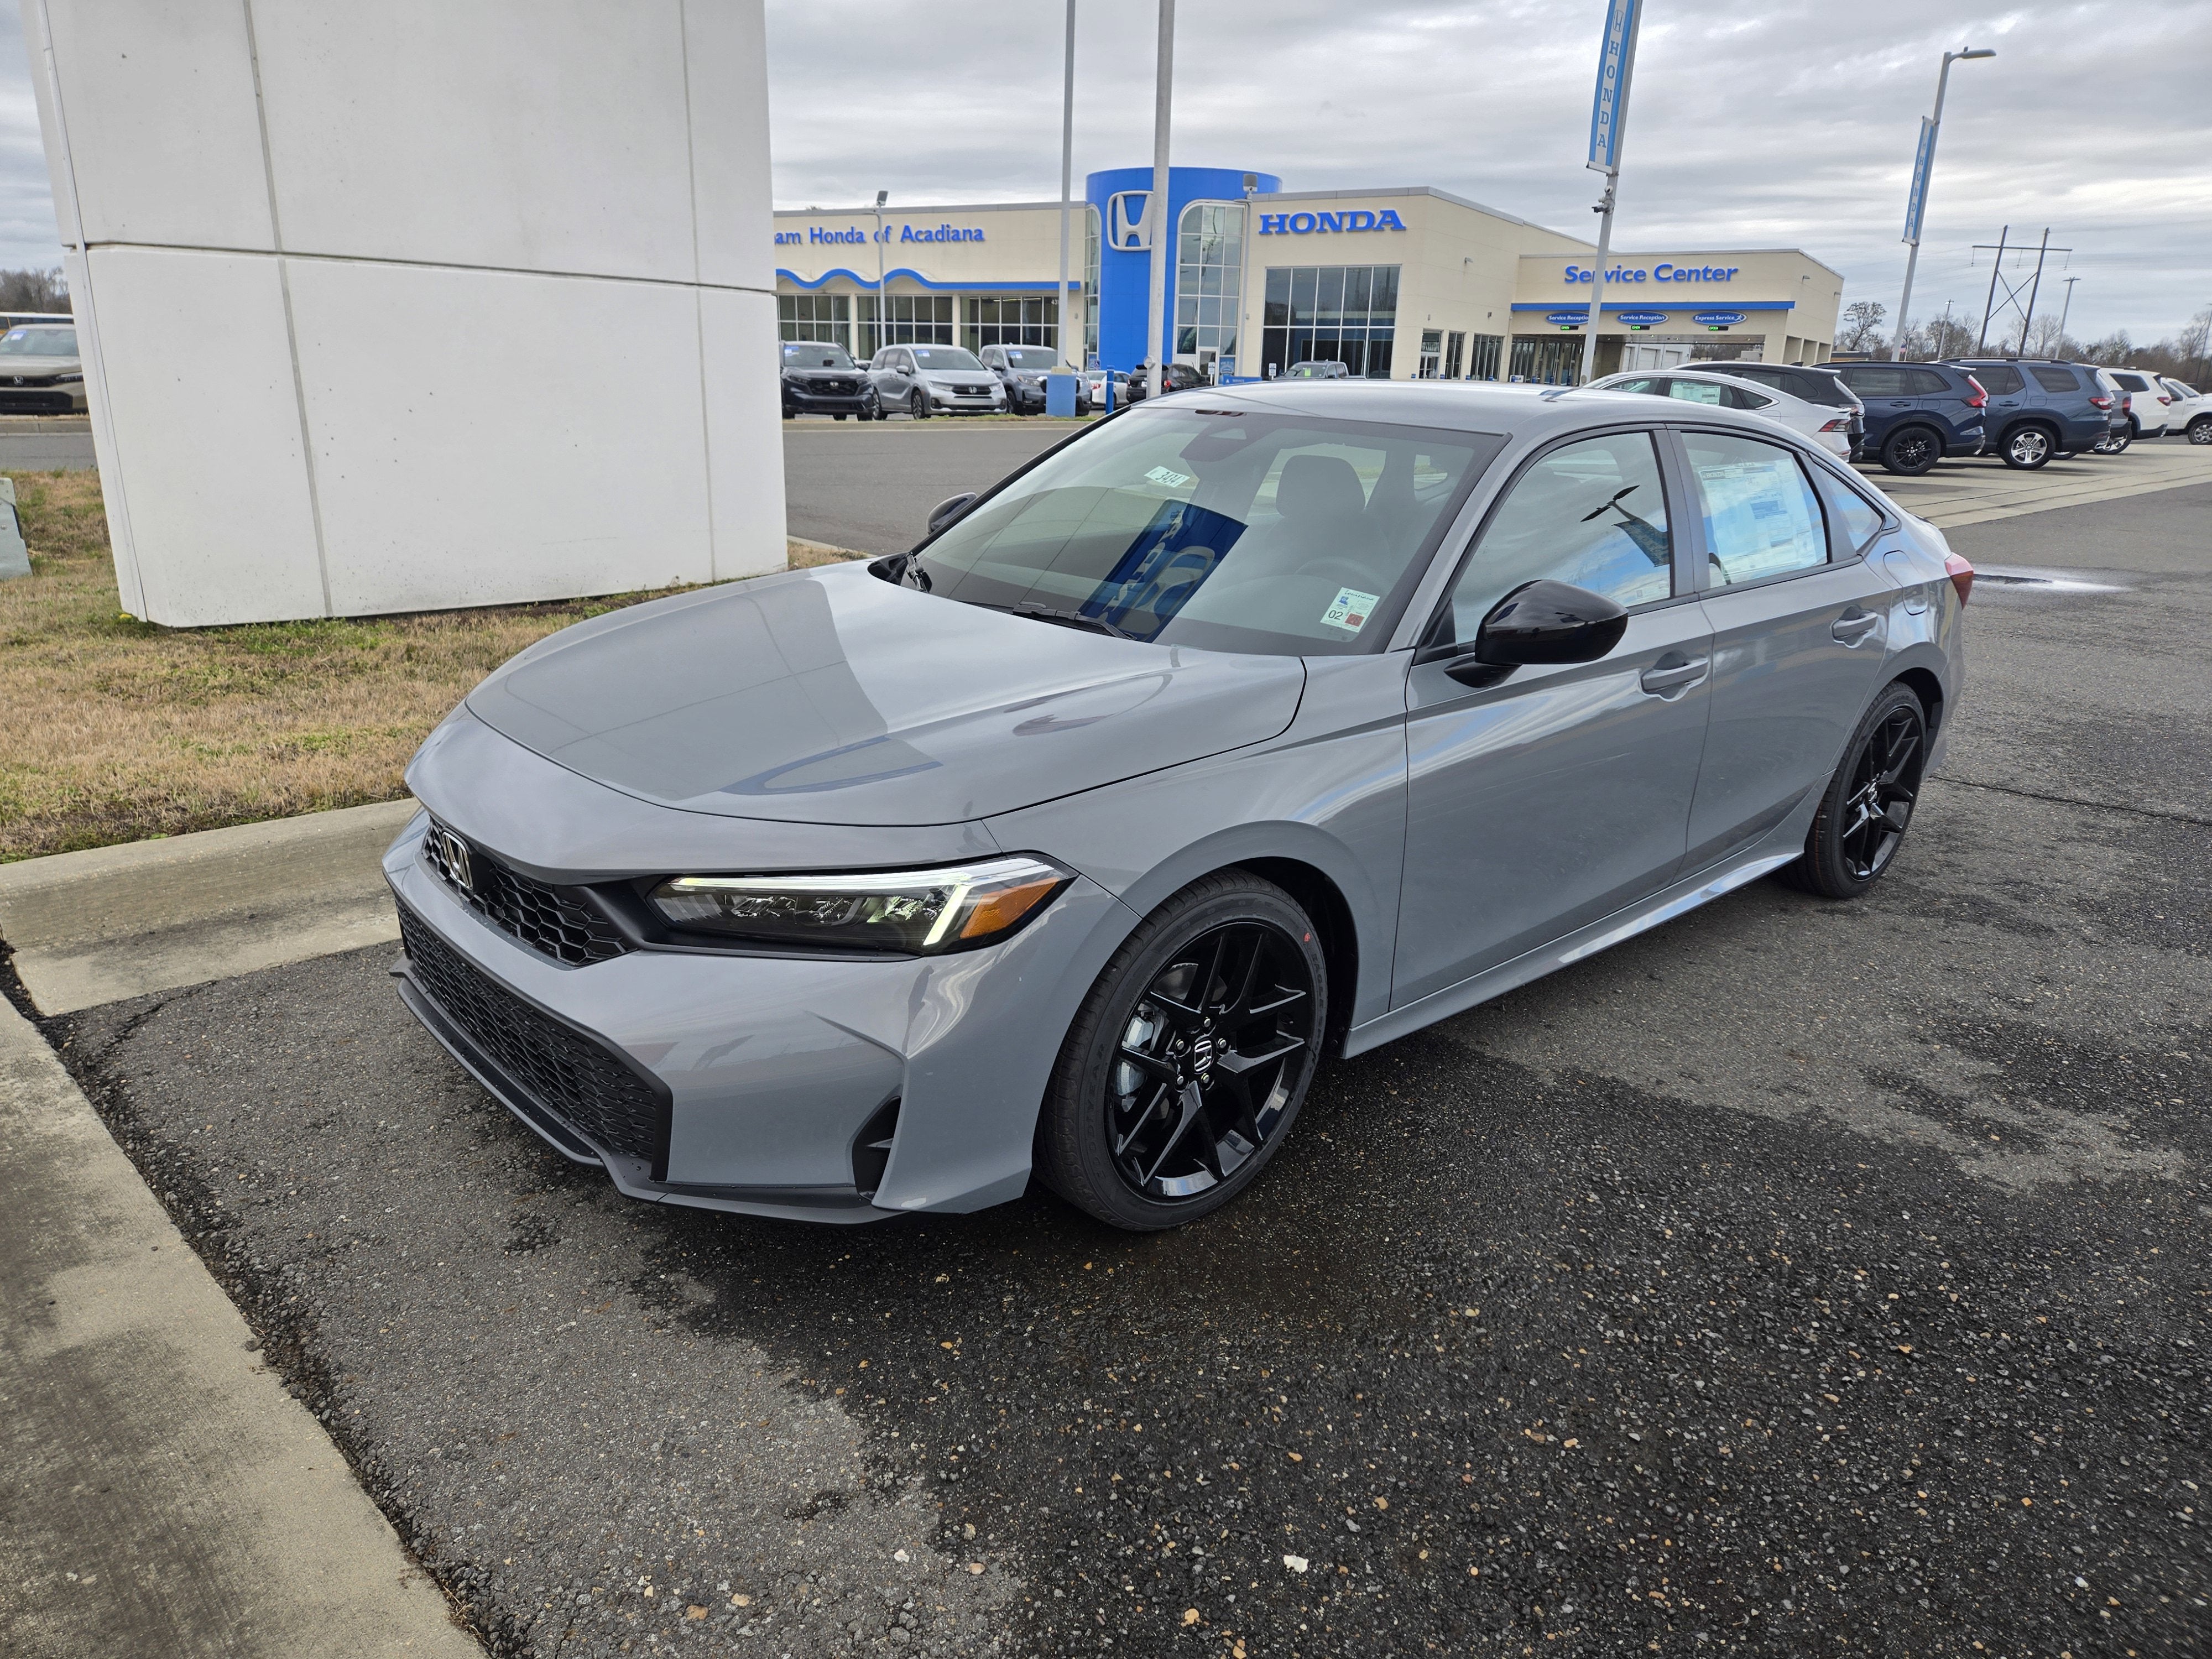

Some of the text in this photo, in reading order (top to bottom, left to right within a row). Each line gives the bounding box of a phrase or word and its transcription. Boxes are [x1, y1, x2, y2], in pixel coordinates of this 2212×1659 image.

[1597, 40, 1619, 148] HONDA
[1909, 156, 1924, 227] HONDA
[1259, 209, 1407, 234] HONDA
[774, 223, 985, 244] am Honda of Acadiana
[1653, 263, 1739, 282] Center
[1328, 610, 1344, 620] 02
